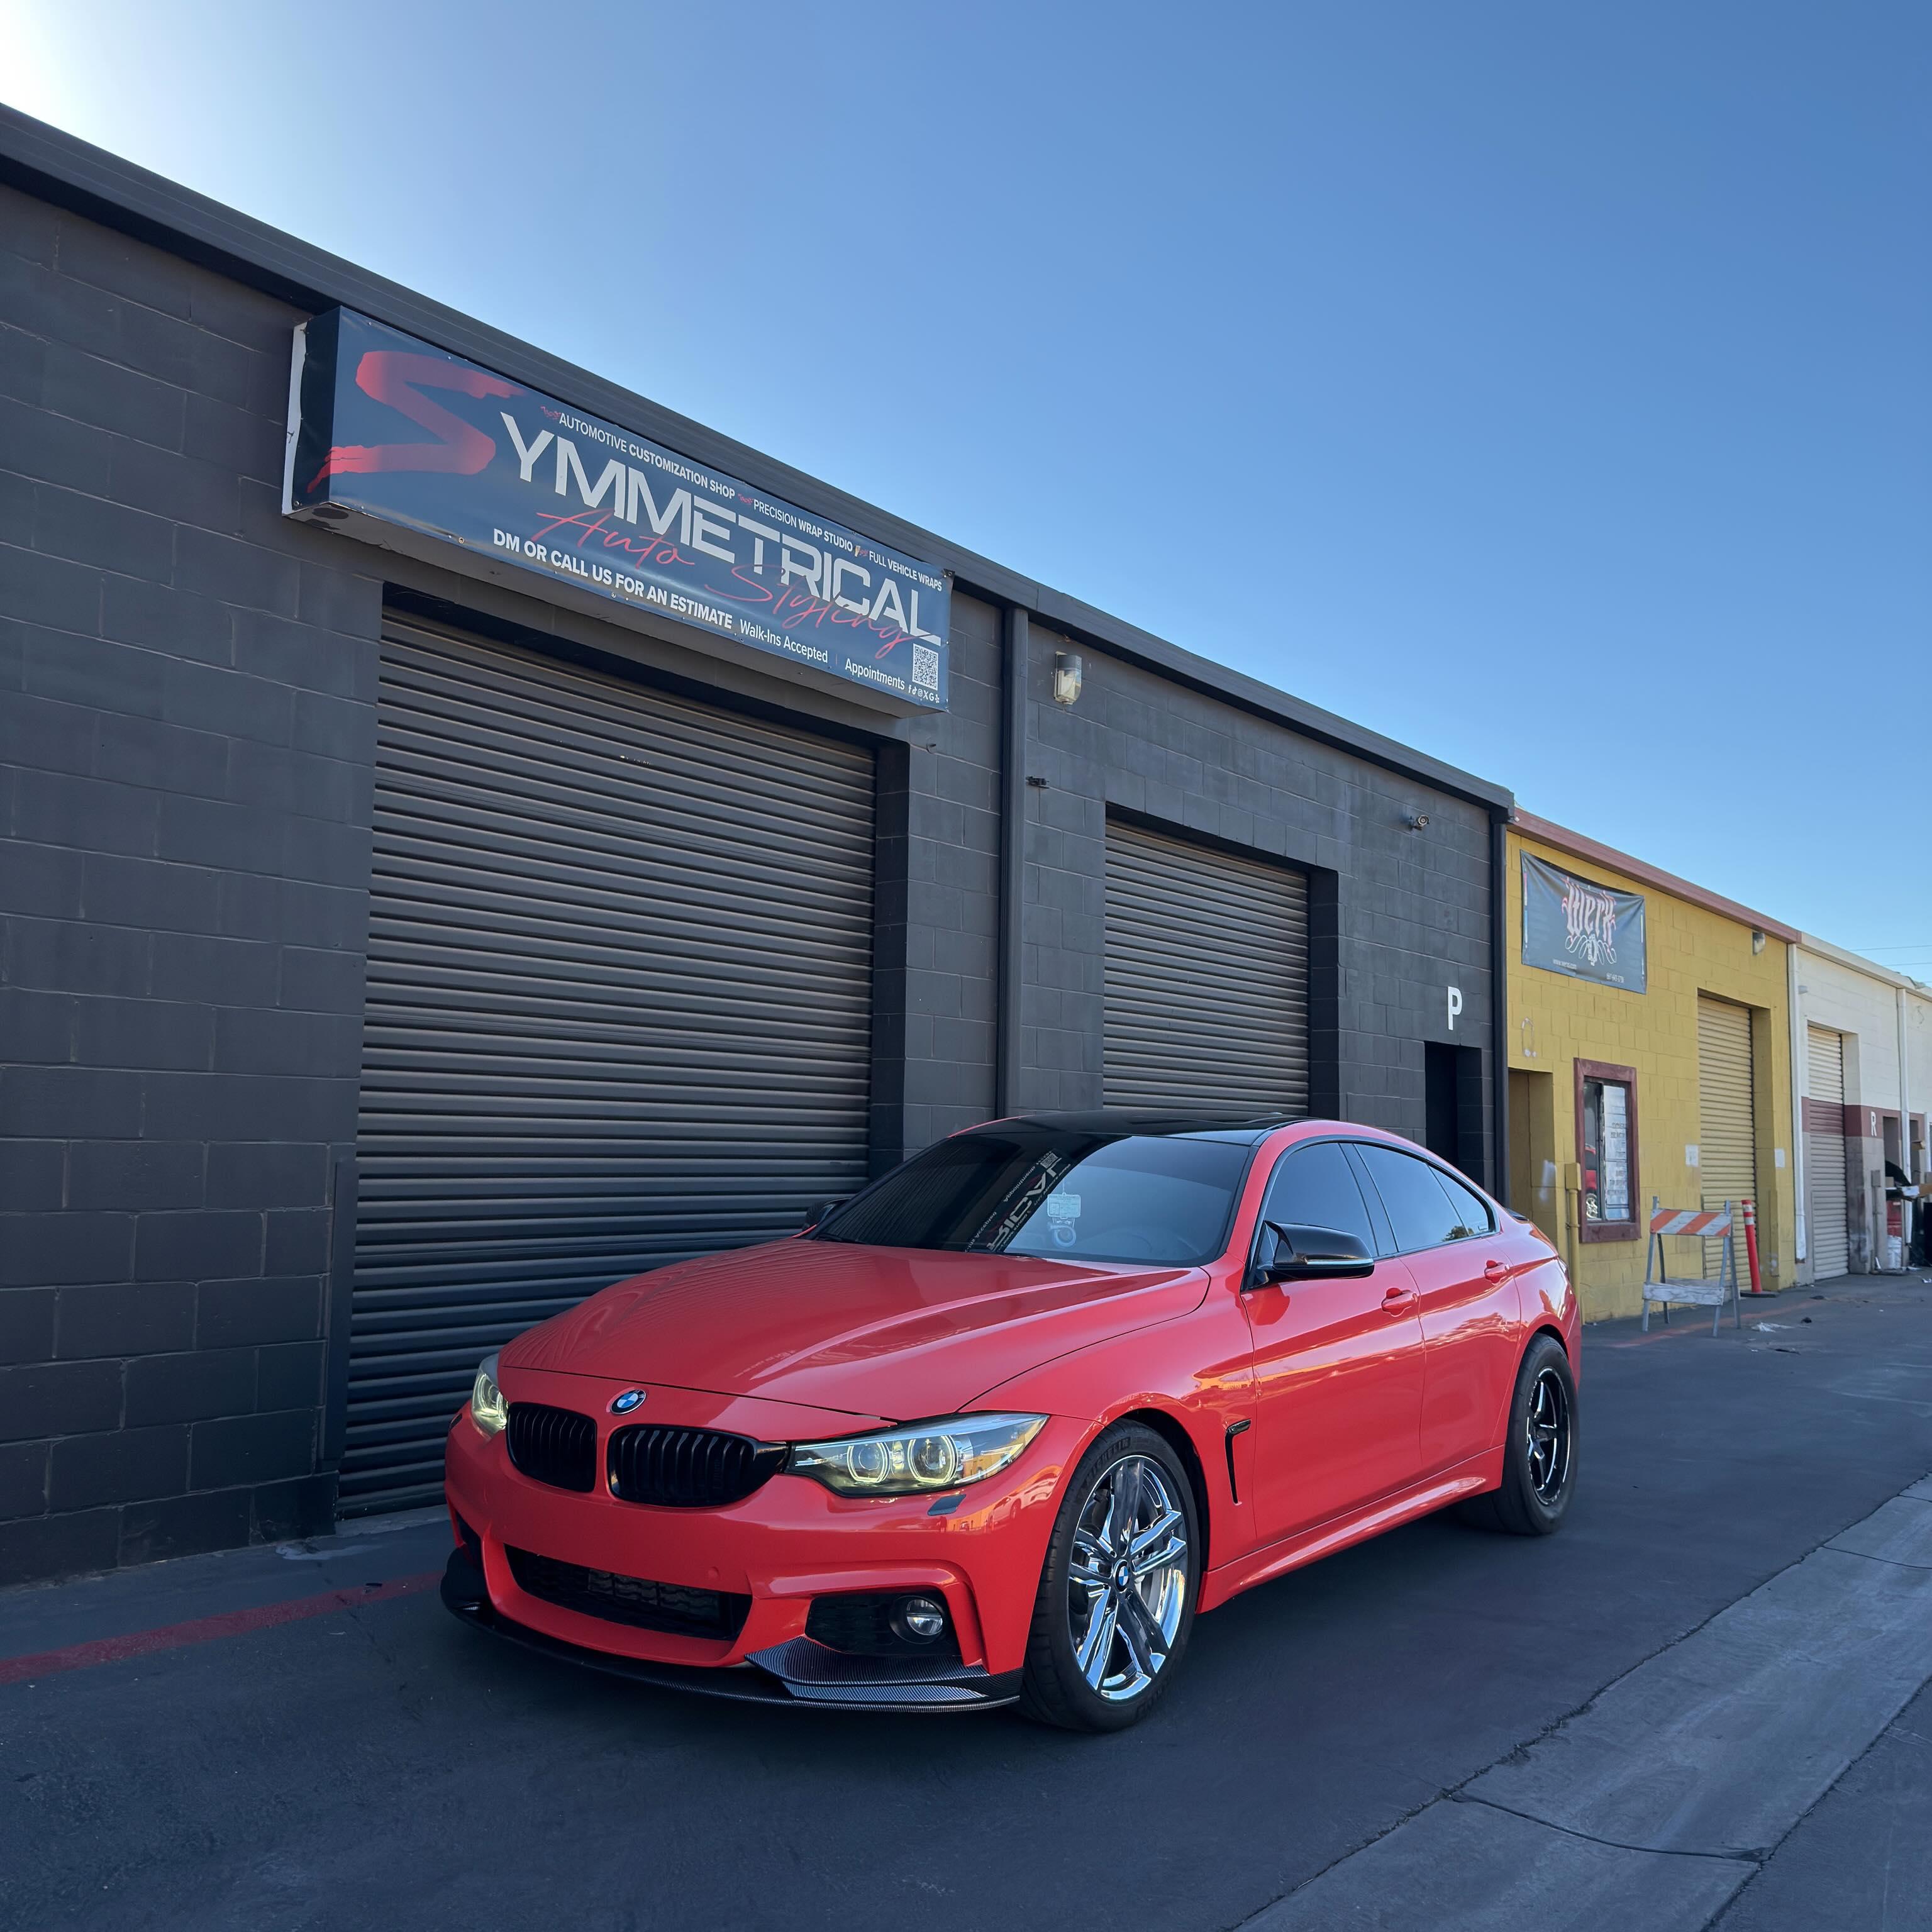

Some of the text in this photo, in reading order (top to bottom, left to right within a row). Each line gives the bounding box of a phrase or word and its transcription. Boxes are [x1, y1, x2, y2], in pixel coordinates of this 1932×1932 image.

[559, 413, 942, 592] AUTOMOTIVE CUSTOMIZATION SHOP PRECISION WRAP STUDIO FULL VEHICLE WRAPS
[493, 528, 905, 690] DM OR CALL US FOR AN ESTIMATE Walk-Ins Accepted Appointments
[531, 507, 931, 658] Auto Styling
[1448, 985, 1462, 1030] P
[1870, 1111, 1877, 1136] R
